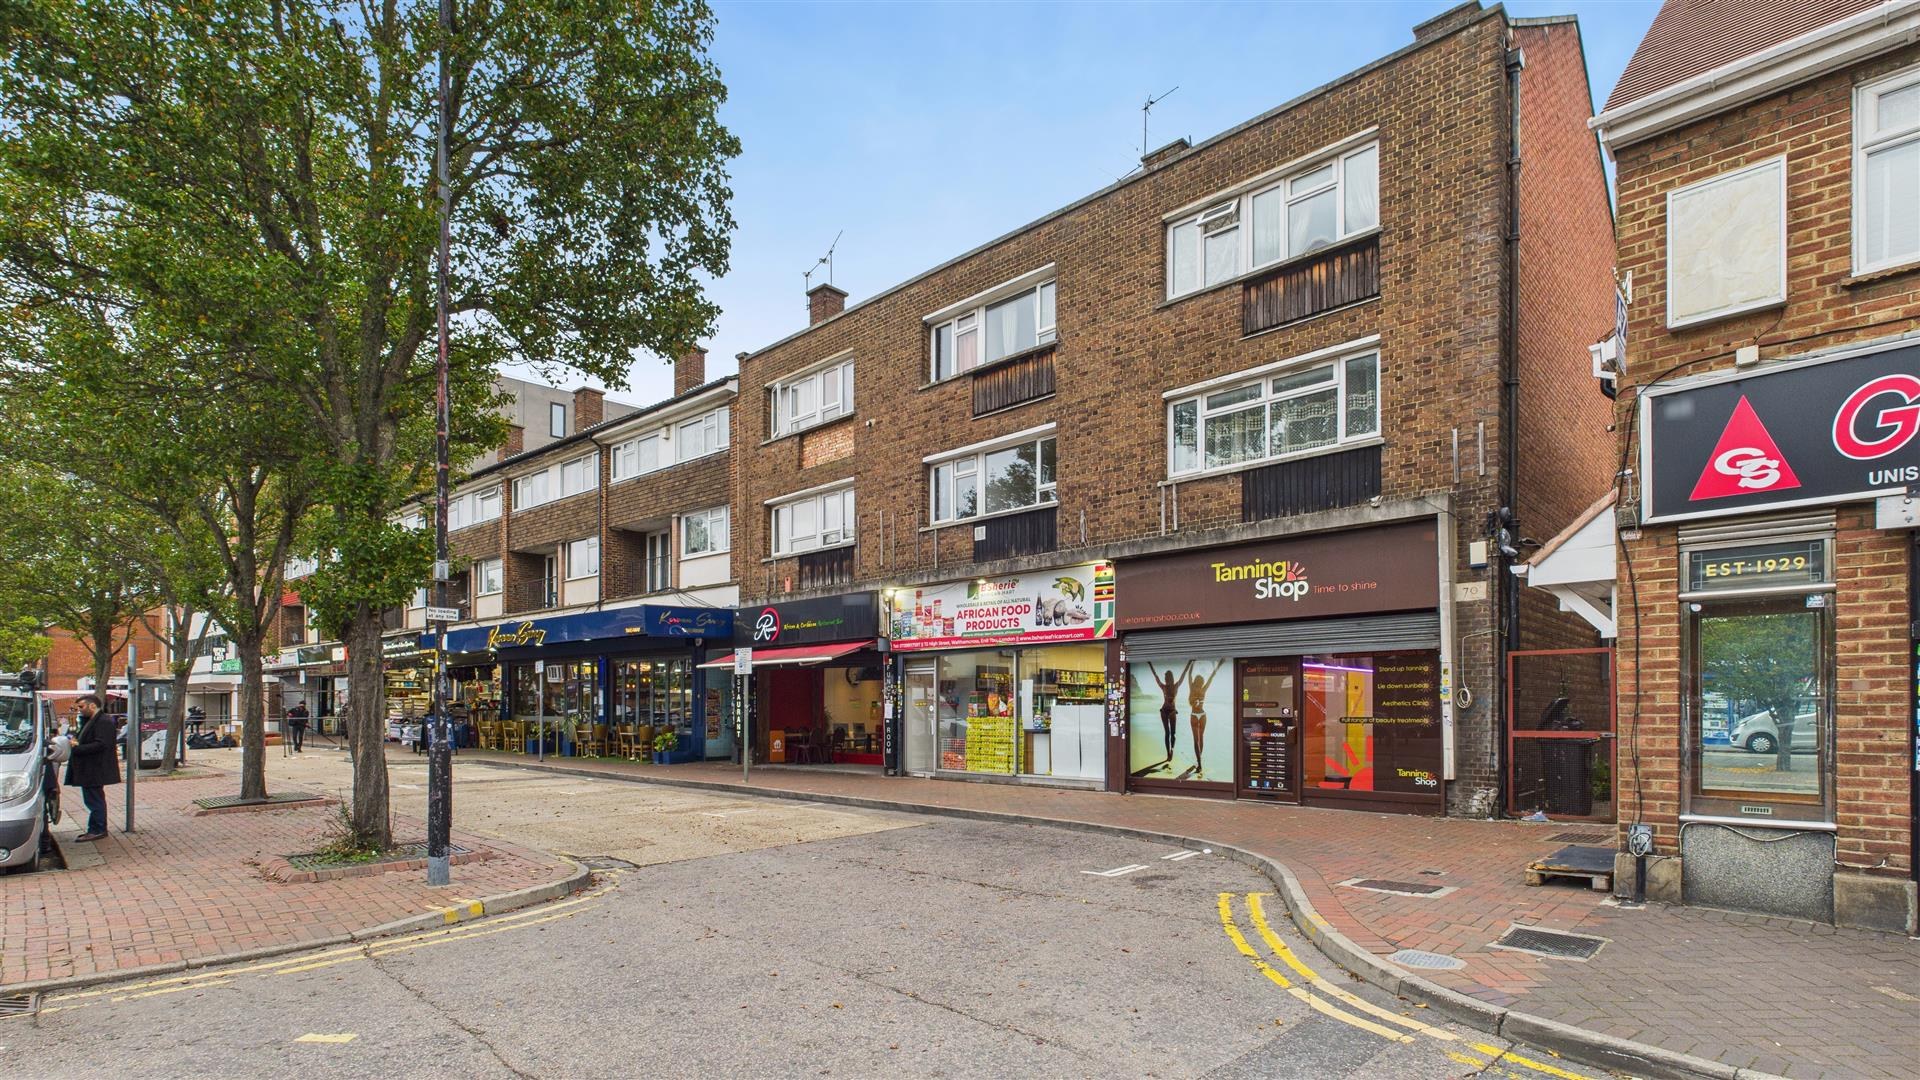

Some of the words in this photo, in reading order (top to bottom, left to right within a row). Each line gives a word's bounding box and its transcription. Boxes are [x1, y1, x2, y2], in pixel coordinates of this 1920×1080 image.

[1869, 466, 1919, 485] UNIS
[1211, 558, 1287, 582] Tanning
[1756, 556, 1806, 573] 1929
[1255, 577, 1309, 602] Shop
[1313, 584, 1336, 594] Time
[1338, 583, 1348, 592] to
[1350, 580, 1377, 591] shine
[956, 607, 999, 620] AFRICAN
[1001, 604, 1031, 616] FOOD
[966, 617, 1020, 631] PRODUCTS
[1396, 768, 1428, 780] Tanning
[1415, 776, 1437, 788] Shop
